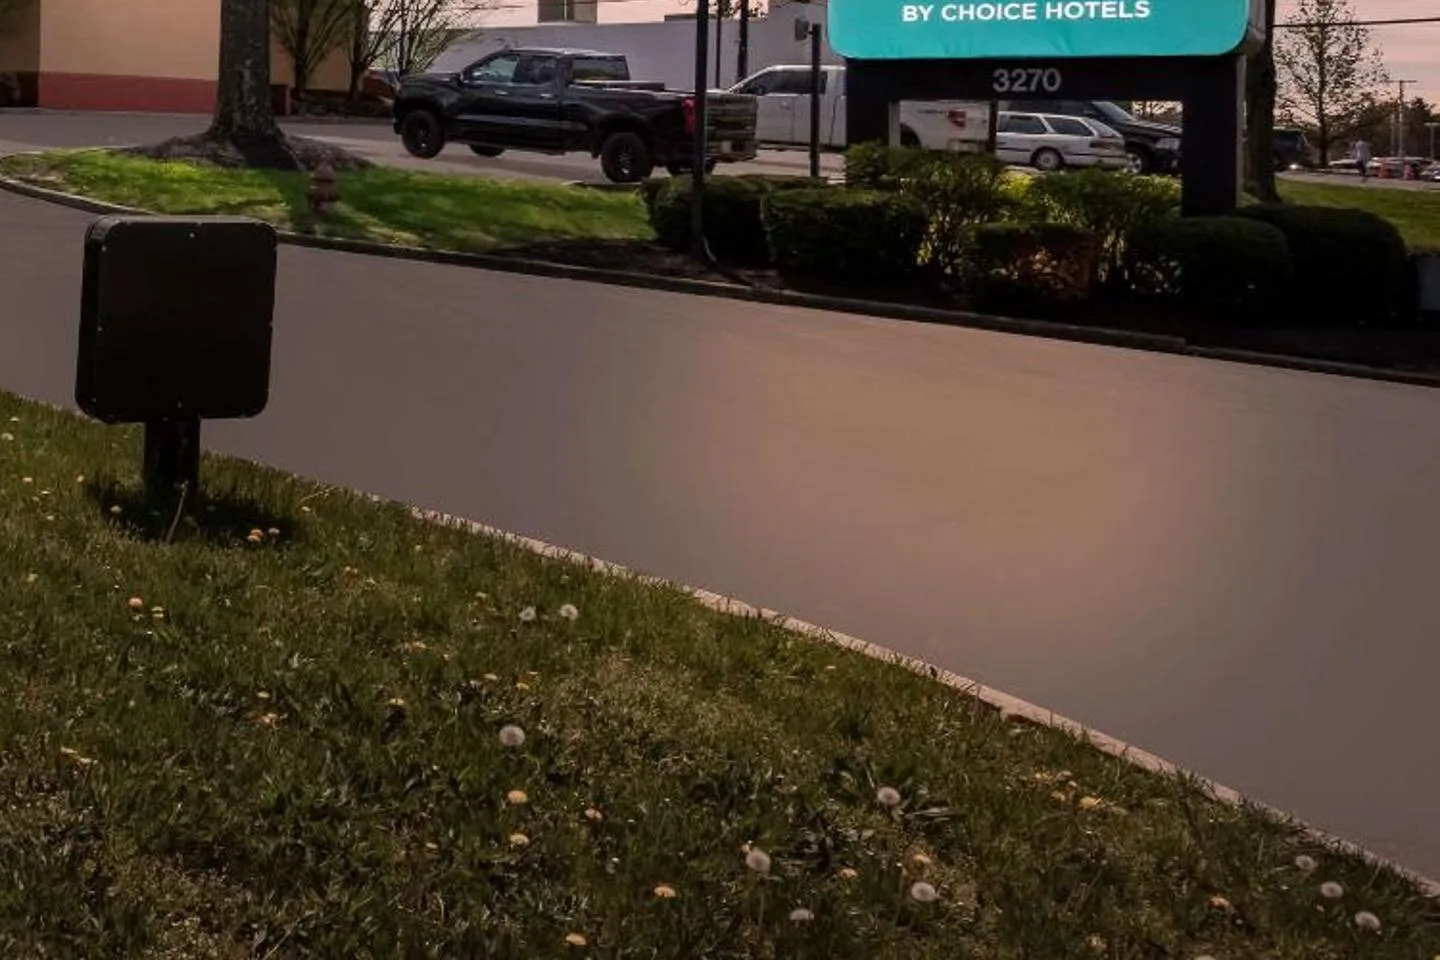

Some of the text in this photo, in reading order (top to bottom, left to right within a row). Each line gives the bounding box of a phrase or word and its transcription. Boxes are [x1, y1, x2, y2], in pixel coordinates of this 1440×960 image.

[902, 0, 1151, 22] BY CHOICE HOTELS
[993, 69, 1061, 92] 3270
